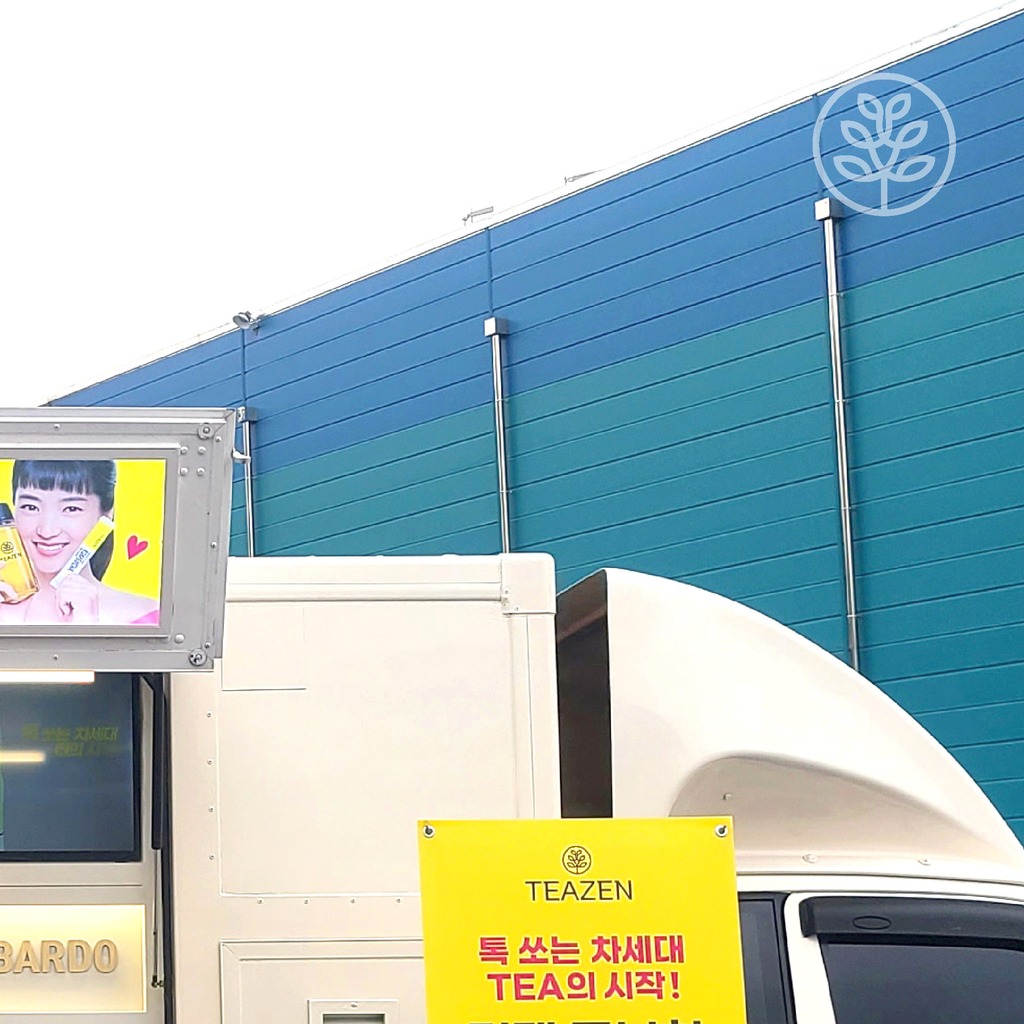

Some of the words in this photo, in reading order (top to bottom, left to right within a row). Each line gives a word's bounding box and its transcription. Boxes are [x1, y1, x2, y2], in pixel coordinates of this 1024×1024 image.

[525, 880, 633, 902] TEAZEN
[478, 936, 509, 966] 톡
[518, 935, 580, 965] 쏘는
[591, 935, 685, 964] 차세대
[487, 971, 596, 1001] TEA의
[604, 971, 681, 1000] 시작!
